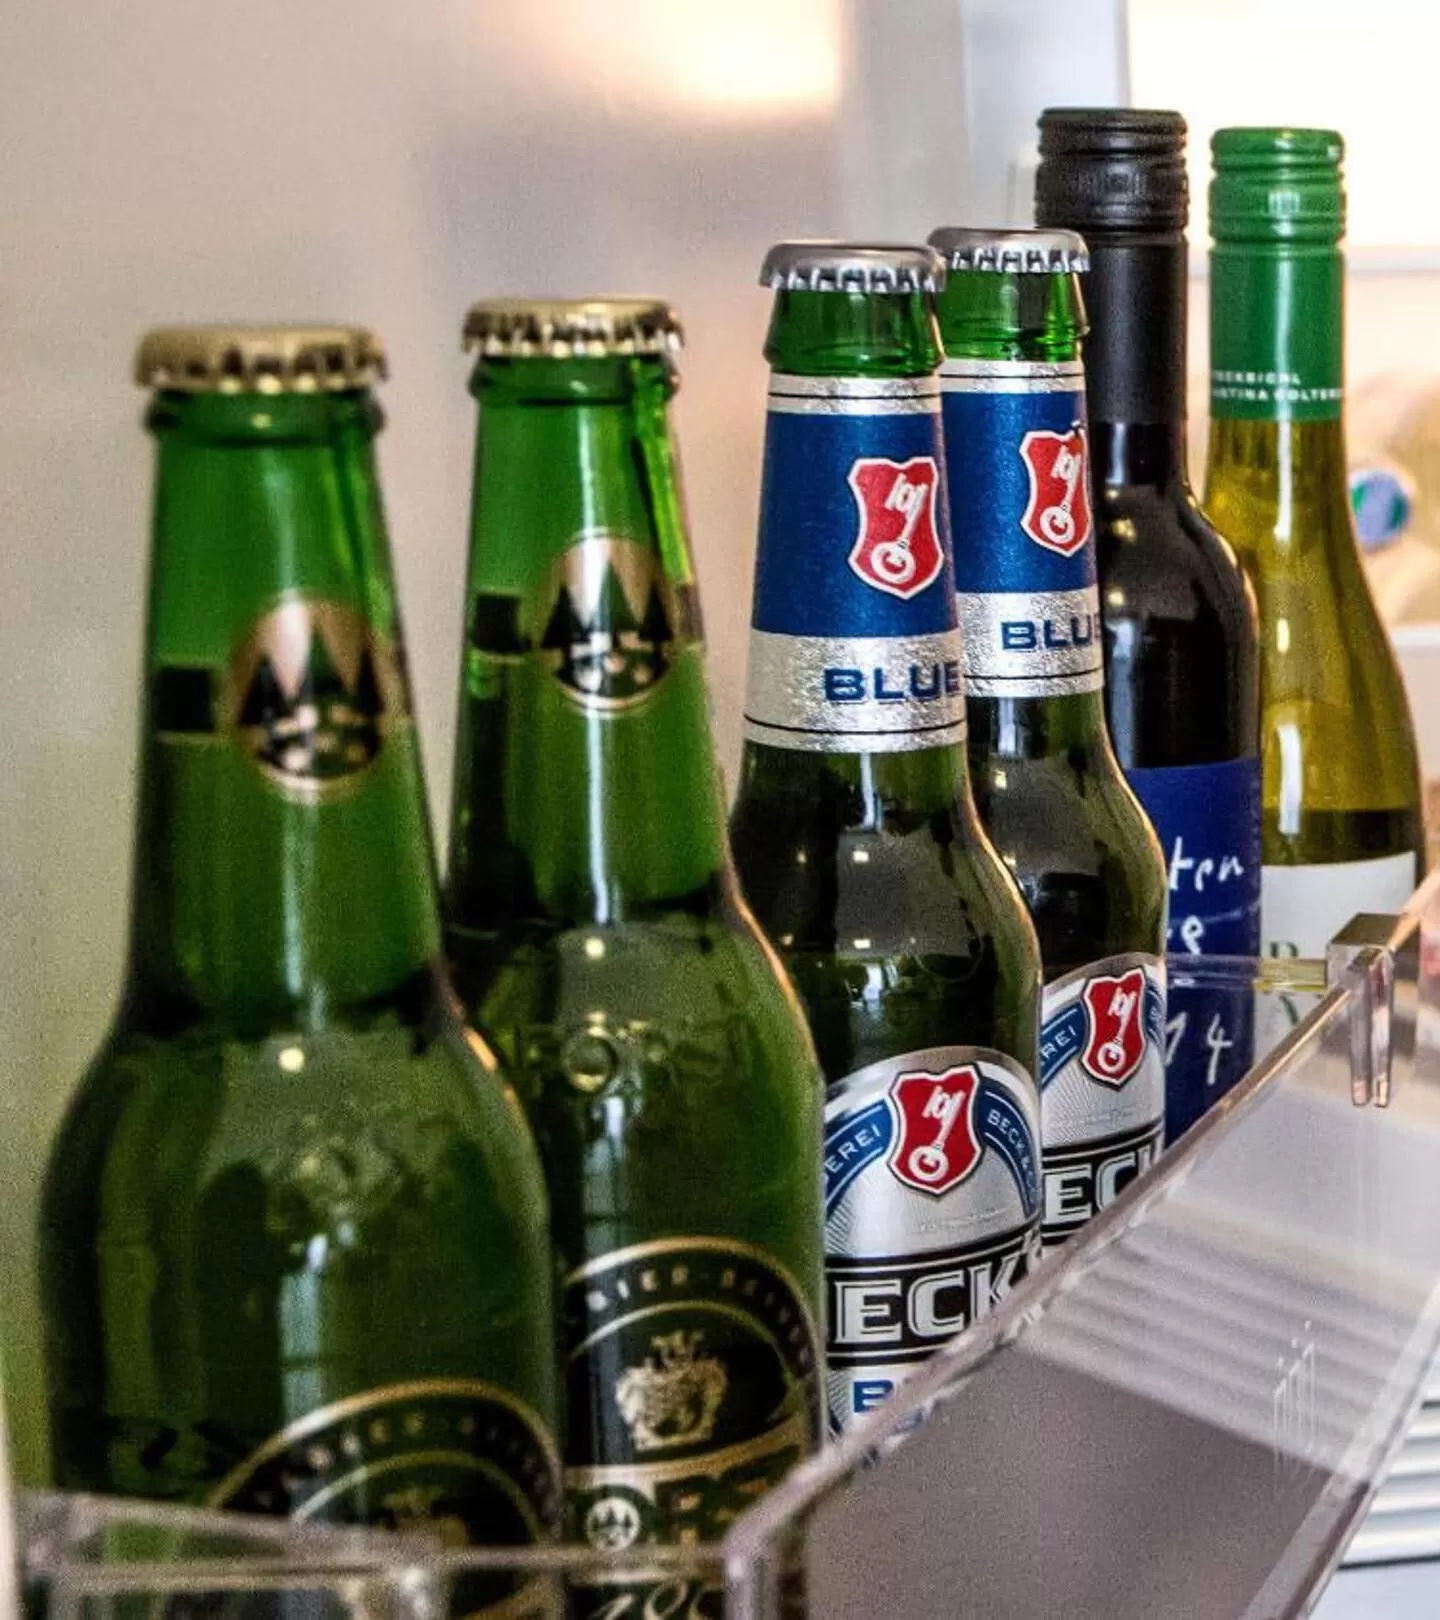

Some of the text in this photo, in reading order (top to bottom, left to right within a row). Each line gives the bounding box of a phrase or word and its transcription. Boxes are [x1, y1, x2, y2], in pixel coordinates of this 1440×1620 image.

[823, 661, 960, 701] BLUE
[1041, 1024, 1077, 1066] REI
[822, 1124, 882, 1182] EREI
